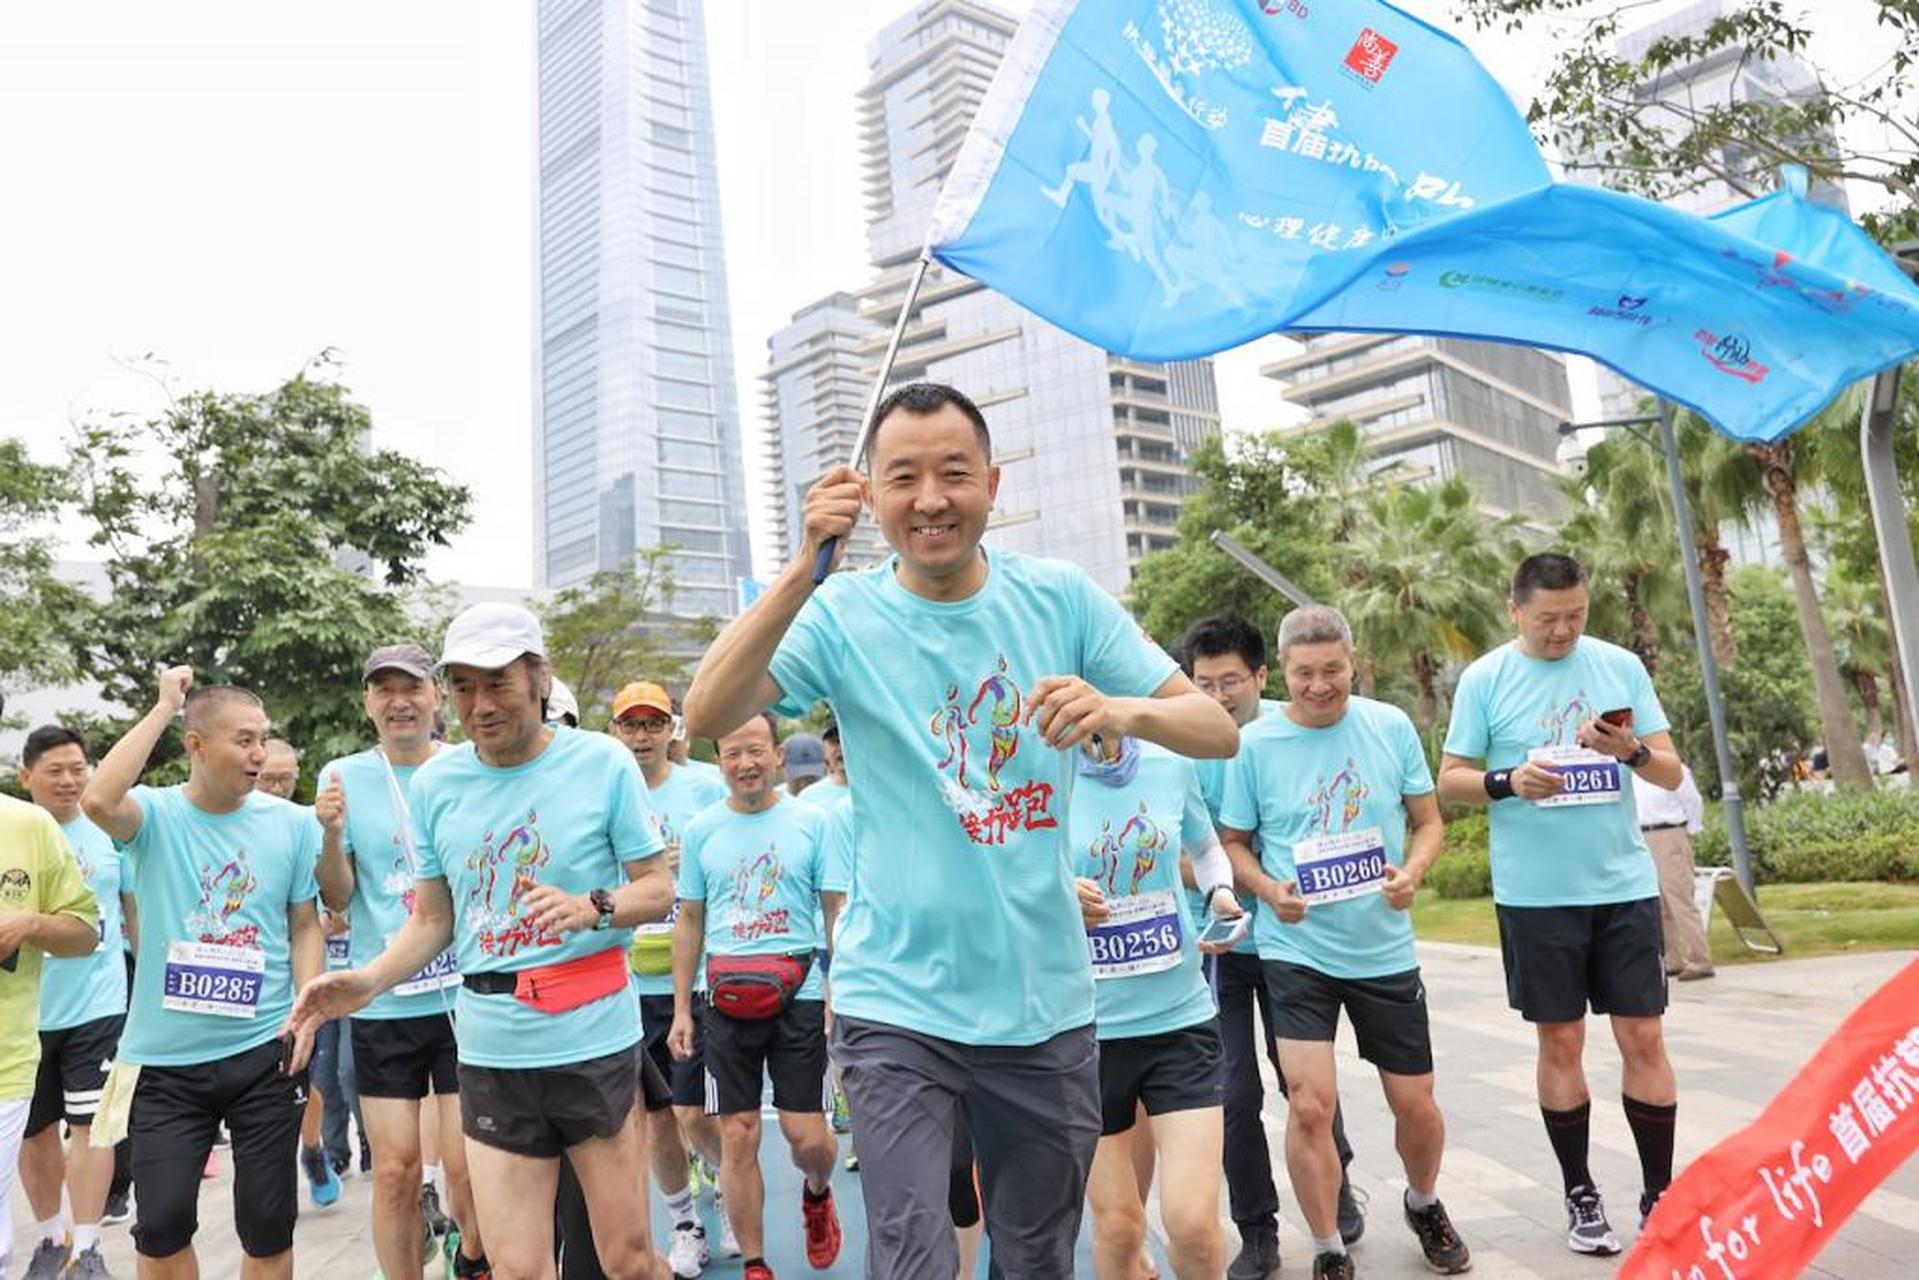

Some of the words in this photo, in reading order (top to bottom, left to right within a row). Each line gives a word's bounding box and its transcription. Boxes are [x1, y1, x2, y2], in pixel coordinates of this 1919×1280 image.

[1562, 769, 1616, 793] 0261
[1311, 855, 1383, 891] B0260
[1089, 924, 1178, 961] B0256
[178, 971, 256, 1002] B0285
[1700, 1215, 1760, 1280] for
[1758, 1140, 1833, 1228] life
